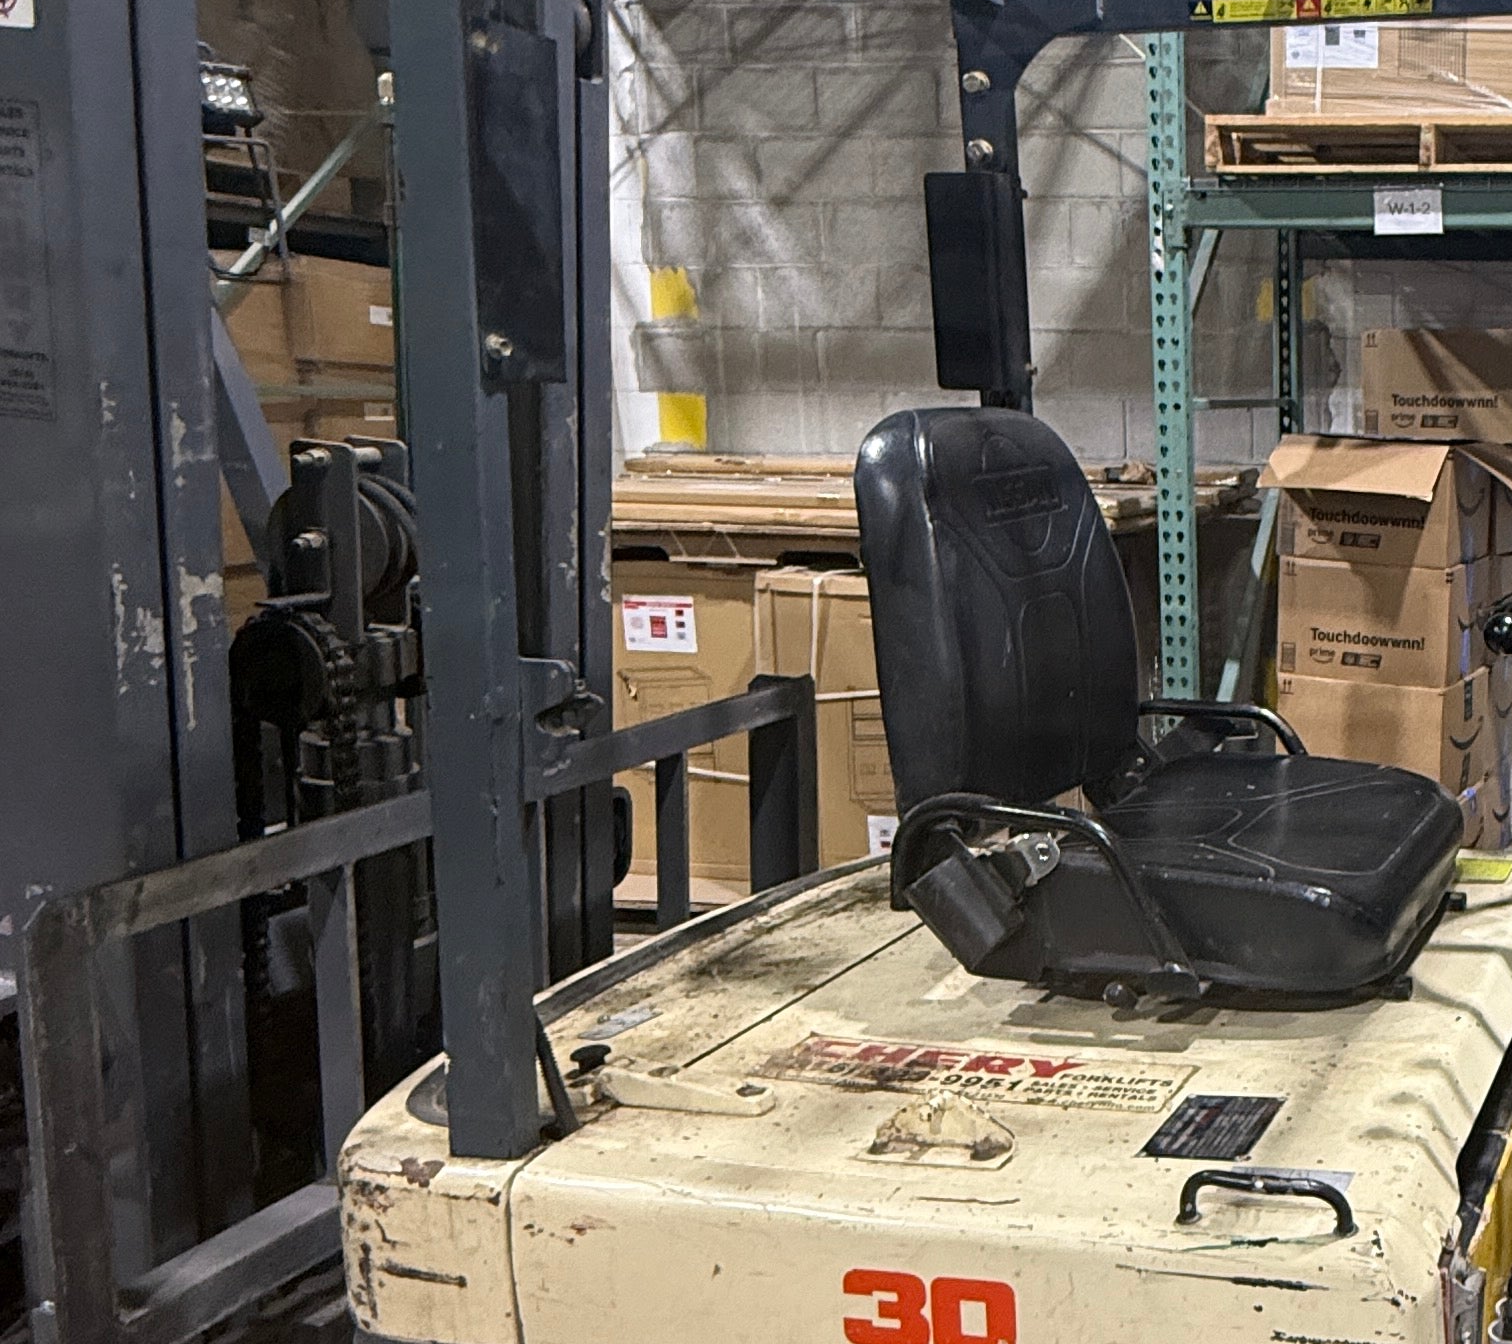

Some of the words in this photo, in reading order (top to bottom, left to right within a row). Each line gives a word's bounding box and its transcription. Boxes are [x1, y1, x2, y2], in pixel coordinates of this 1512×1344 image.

[1388, 202, 1430, 216] W-1-2
[1391, 393, 1499, 409] Touchdoowwnn!
[1310, 508, 1425, 530] Touchdoowwnn!
[1310, 628, 1425, 651] Touchdoowwnn!
[1030, 1080, 1078, 1091] SALES
[1090, 1084, 1157, 1095] SERVICE
[1058, 1073, 1174, 1087] FORKLIFTS
[1022, 1086, 1076, 1098] PARTS
[1087, 1091, 1158, 1102] RENTALS
